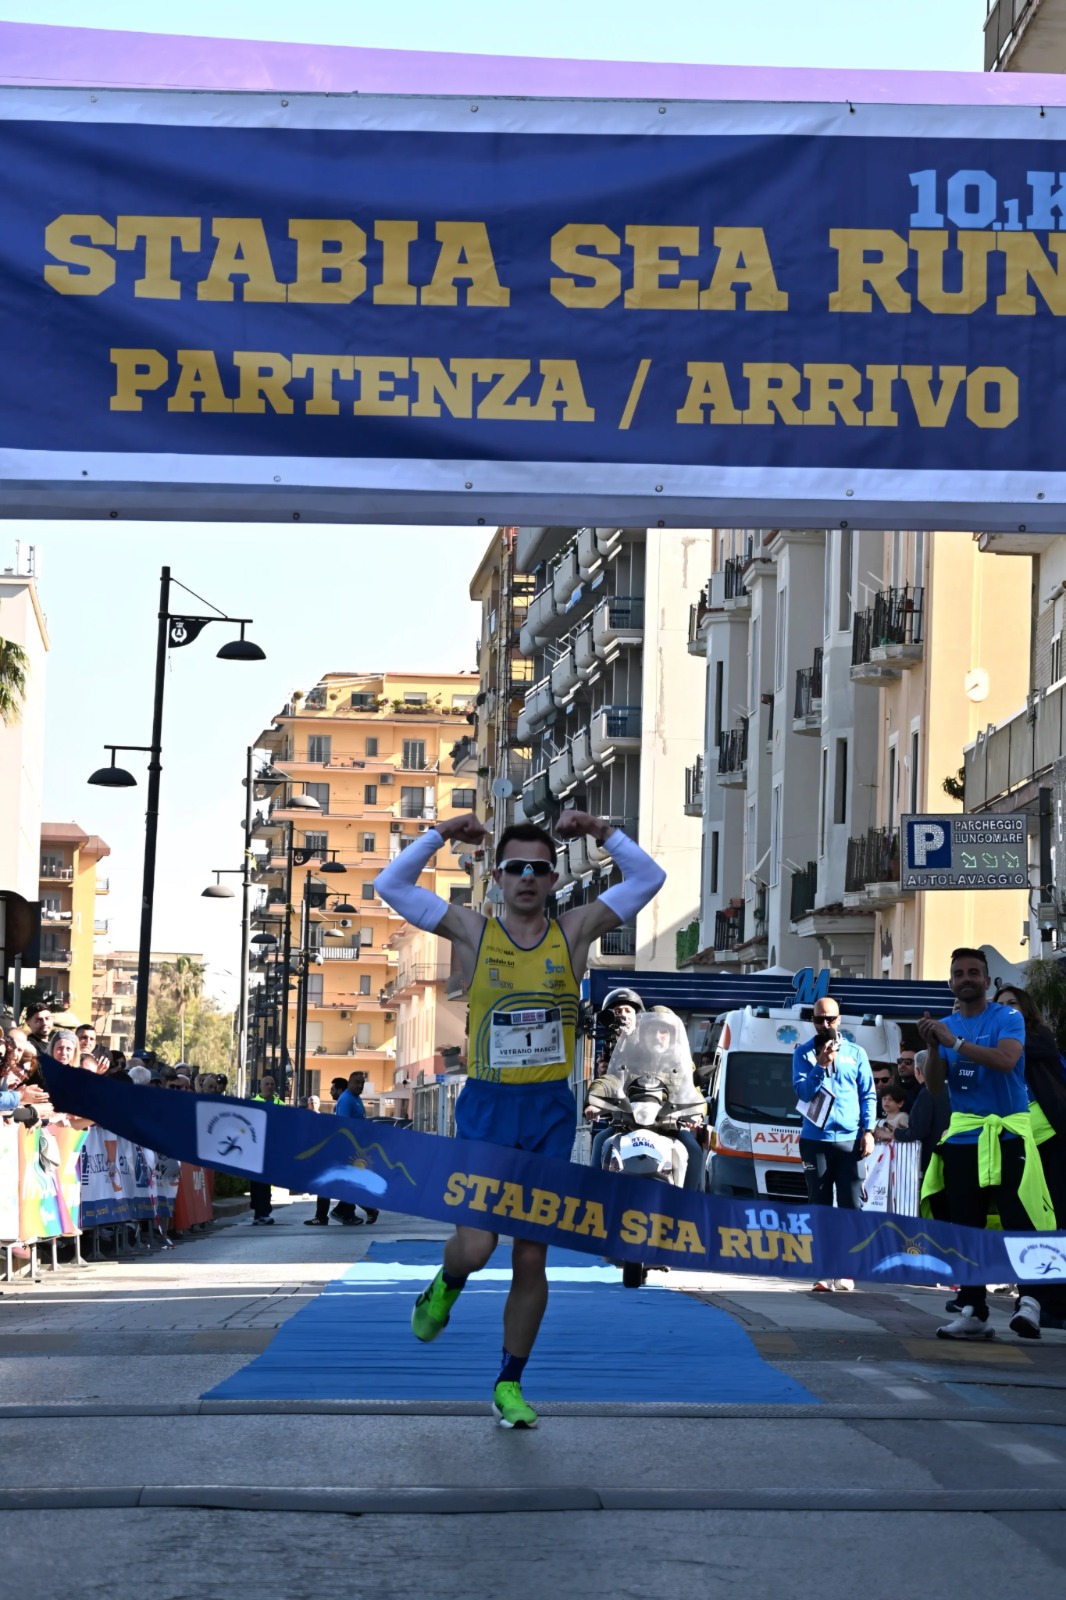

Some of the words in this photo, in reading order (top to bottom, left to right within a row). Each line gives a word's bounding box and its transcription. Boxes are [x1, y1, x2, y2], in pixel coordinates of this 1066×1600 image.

[44, 213, 511, 308] STABIA
[549, 223, 789, 312] SEA
[828, 228, 1066, 317] RUN
[109, 347, 595, 422] PARTENZA
[676, 361, 1019, 428] ARRIVO
[955, 820, 1023, 831] PARCHEGGIO
[955, 833, 1023, 843] LUNGOMARE
[913, 823, 945, 866] P
[907, 874, 1024, 885] AUTOLAVAGGIO
[525, 1031, 532, 1047] 1
[443, 1171, 608, 1240] STABIA
[620, 1209, 706, 1255] SEA
[718, 1226, 814, 1264] RUN
